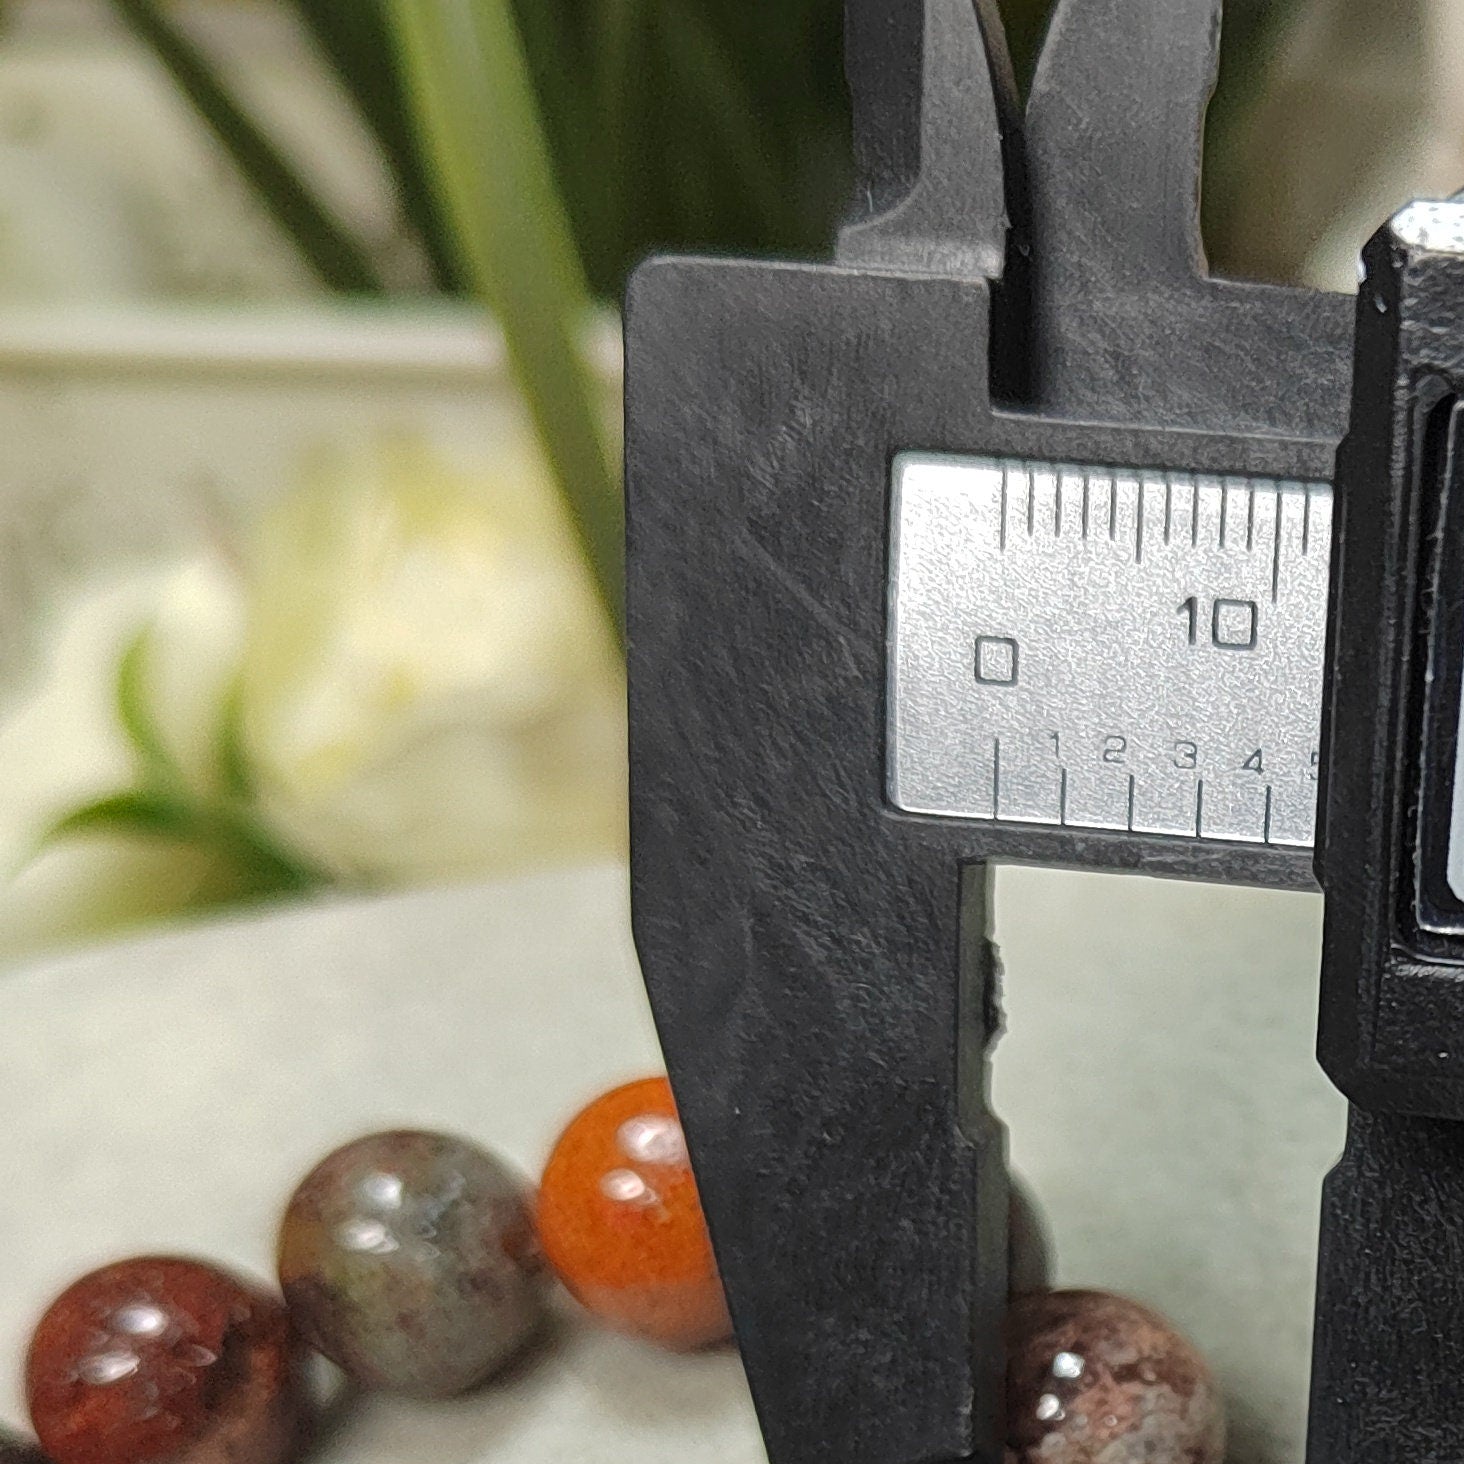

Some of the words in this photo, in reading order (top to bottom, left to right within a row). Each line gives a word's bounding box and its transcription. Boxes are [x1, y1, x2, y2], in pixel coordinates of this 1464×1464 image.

[1175, 595, 1258, 651] 10
[974, 634, 1019, 687] 0
[1050, 730, 1060, 758] 1
[1103, 735, 1128, 764] 2
[1173, 741, 1198, 770] 3
[1242, 748, 1264, 775] 4
